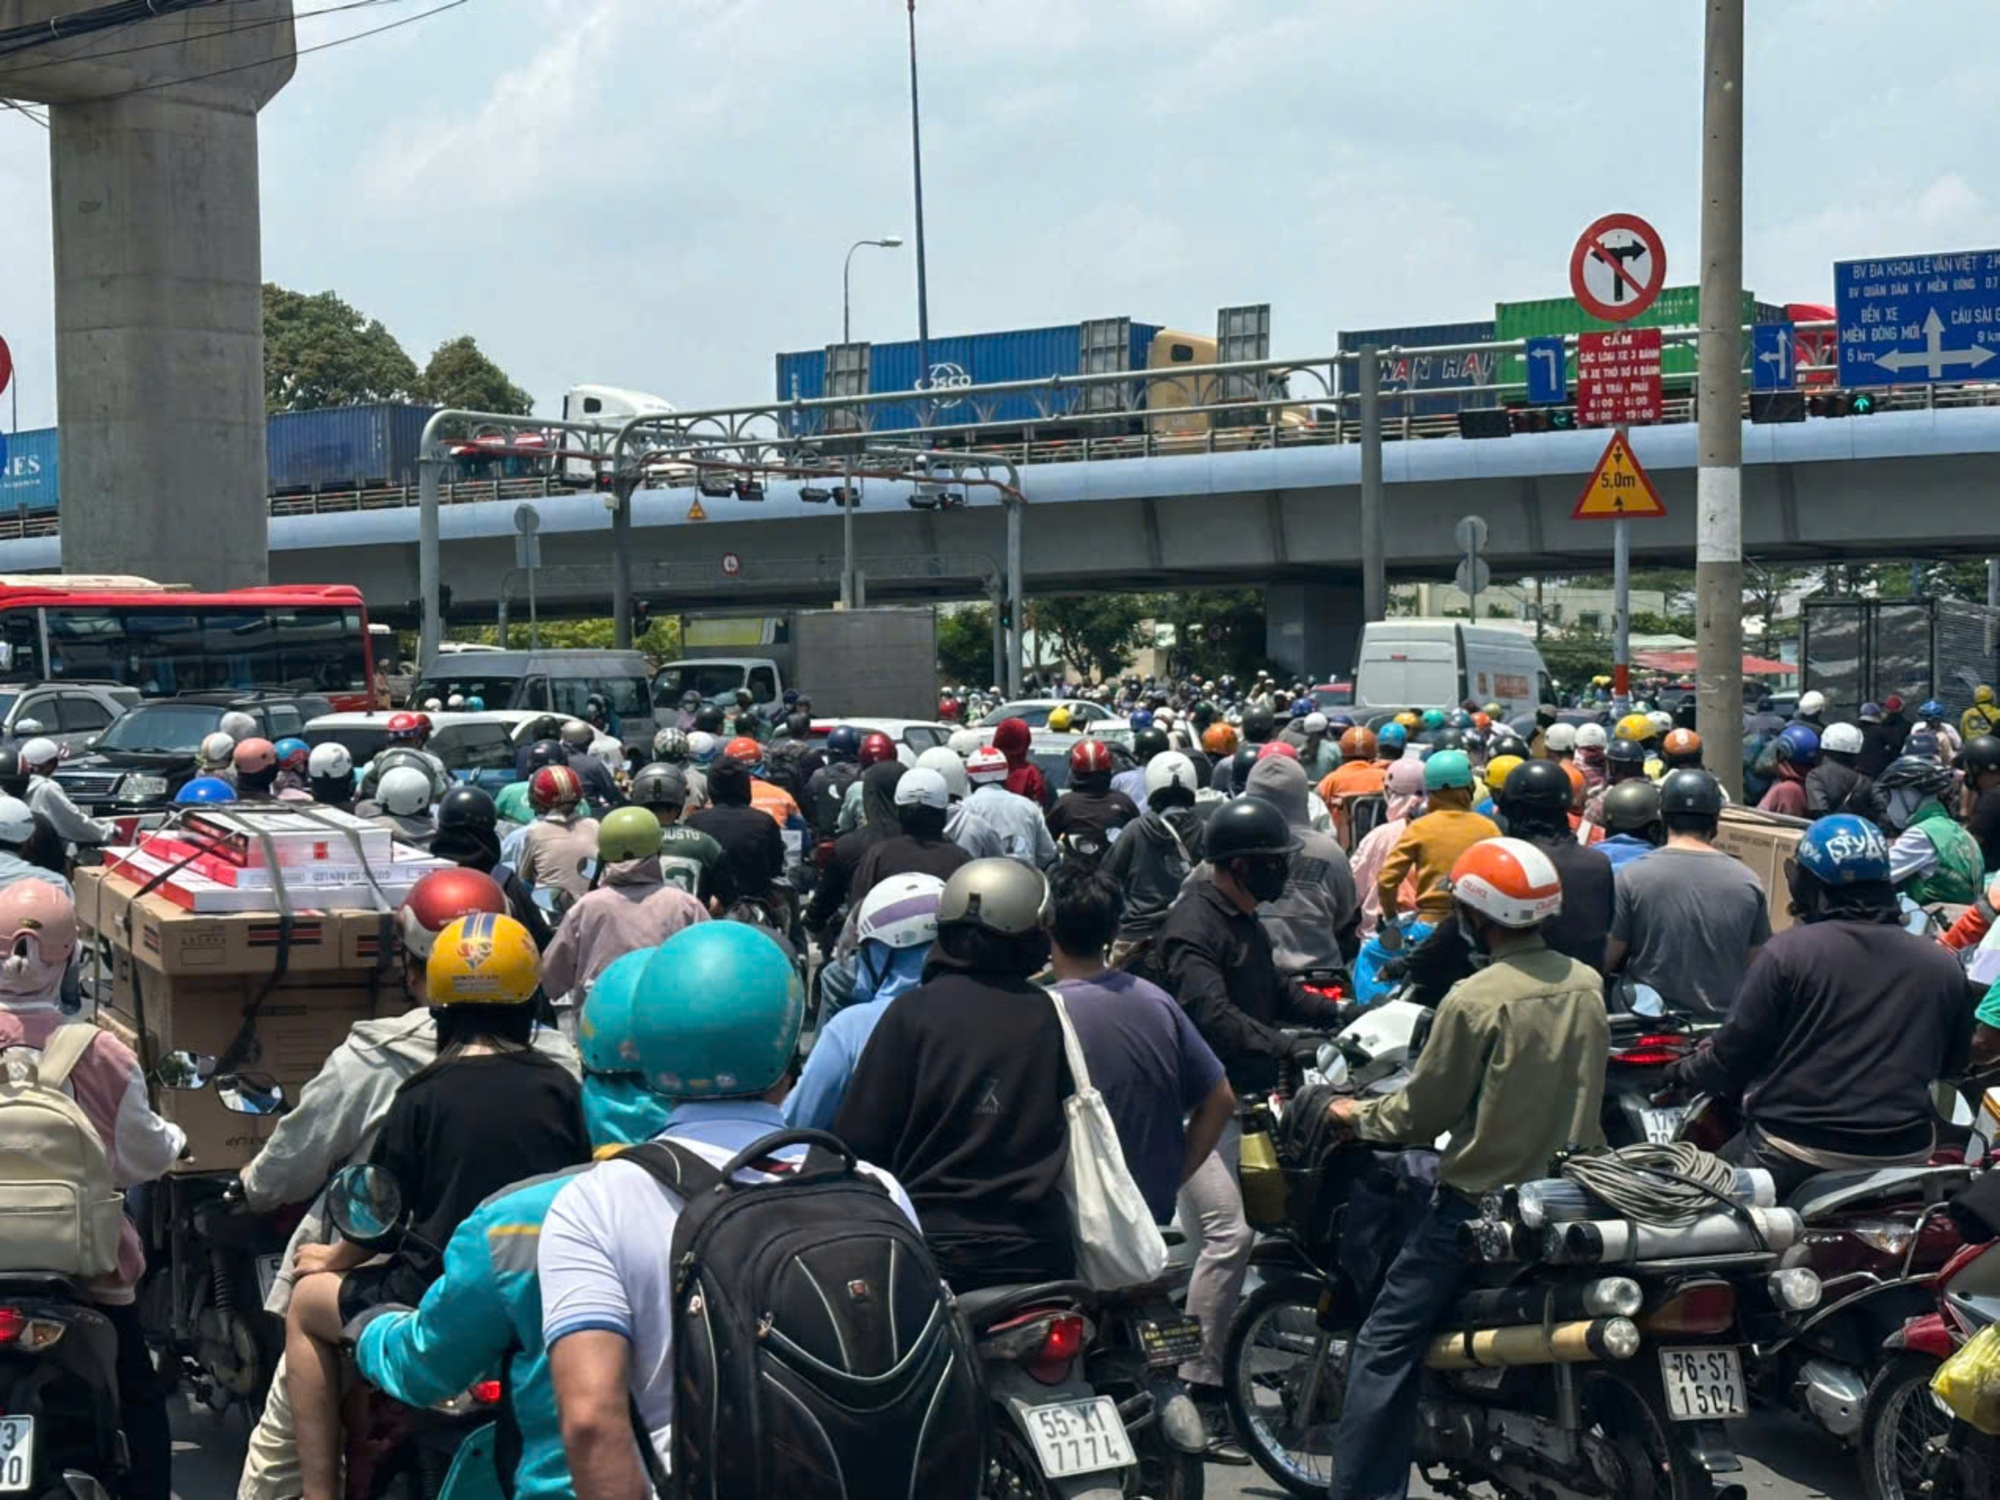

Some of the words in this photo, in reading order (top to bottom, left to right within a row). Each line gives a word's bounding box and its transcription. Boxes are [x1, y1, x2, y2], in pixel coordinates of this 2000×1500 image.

[1853, 264, 1867, 279] BV
[1887, 261, 1915, 276] KHOA
[1914, 280, 1921, 294] Y
[1861, 302, 1880, 323] BẾN
[1885, 306, 1899, 321] XE
[1602, 331, 1632, 346] CẤM
[1977, 330, 1984, 343] 9
[1847, 348, 1854, 363] 6
[1857, 348, 1875, 362] km
[1601, 471, 1636, 489] 5.0m
[1673, 1352, 1728, 1383] 76-S7
[1680, 1384, 1738, 1415] 1502
[1038, 1403, 1106, 1439] 55-X1
[1050, 1434, 1120, 1471] 7774
